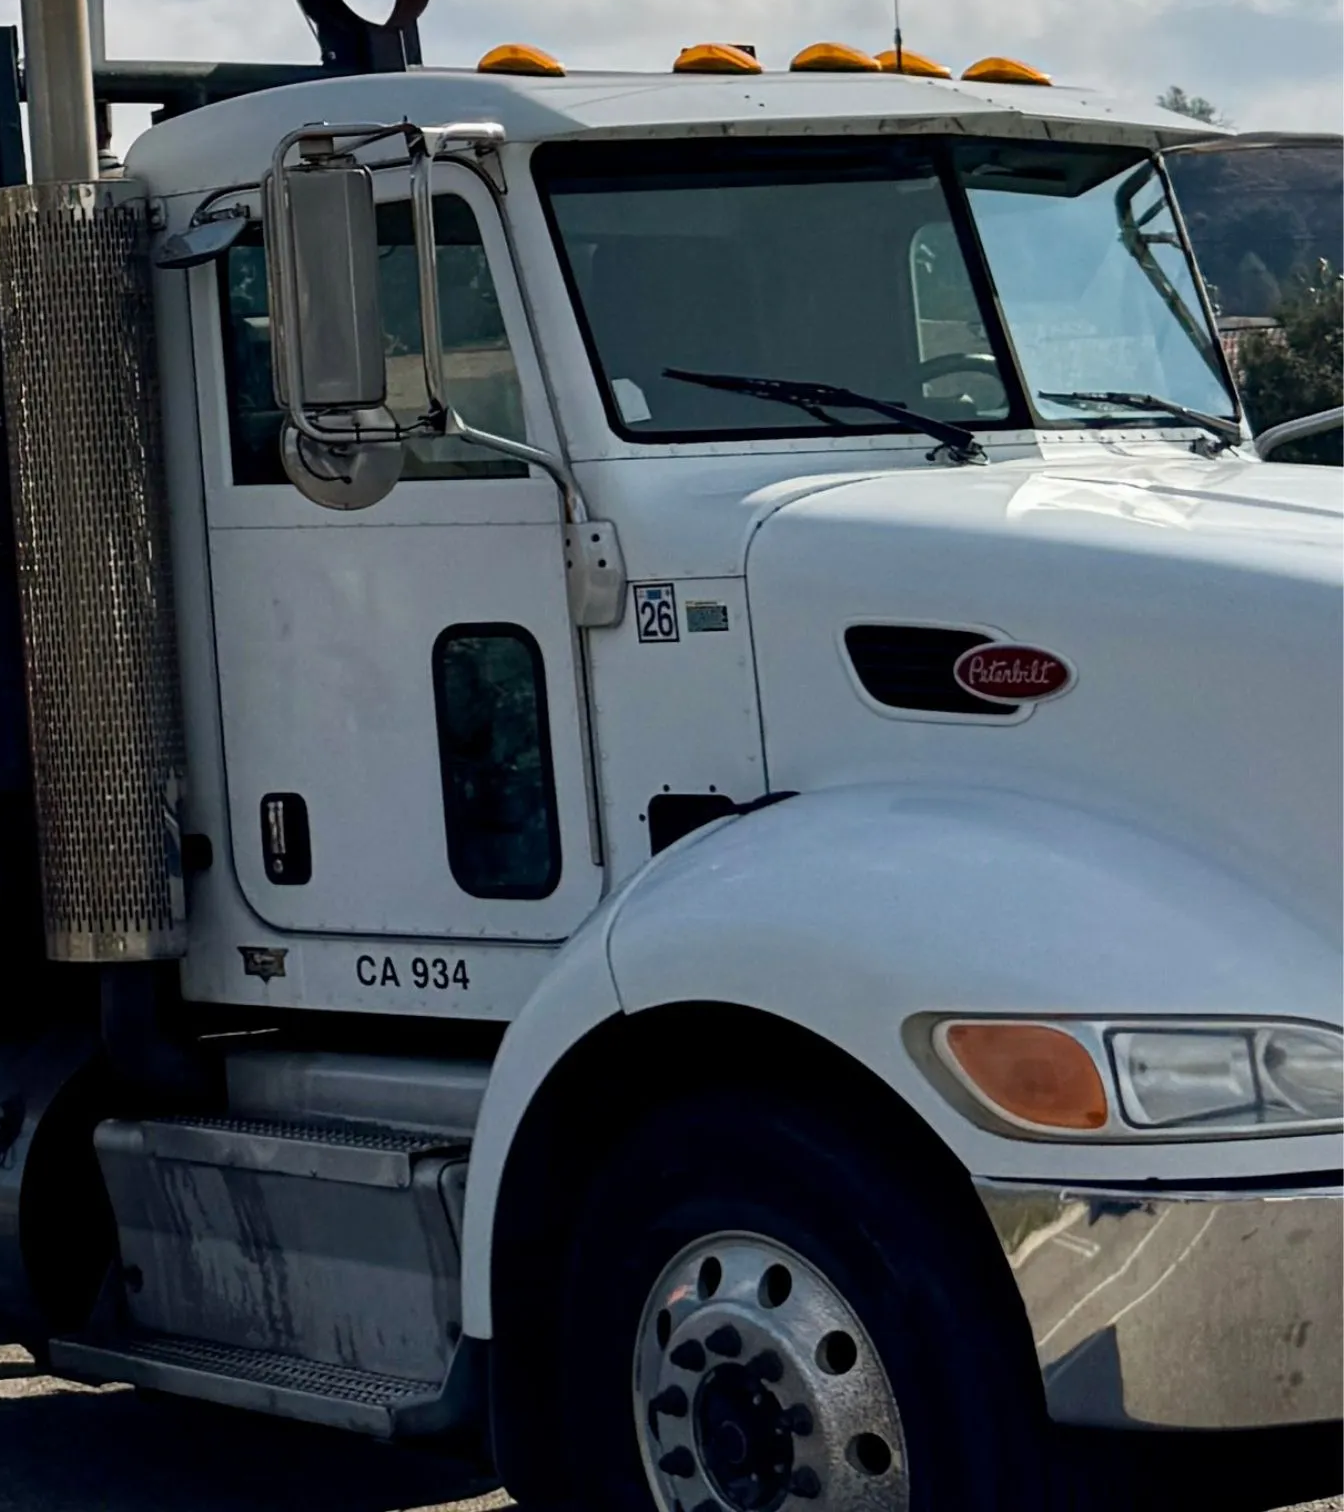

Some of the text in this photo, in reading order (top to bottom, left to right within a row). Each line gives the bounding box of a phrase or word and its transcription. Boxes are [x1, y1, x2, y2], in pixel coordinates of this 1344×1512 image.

[640, 600, 673, 637] 26
[968, 655, 1057, 685] Peterbilt
[356, 955, 470, 990] CA 934
